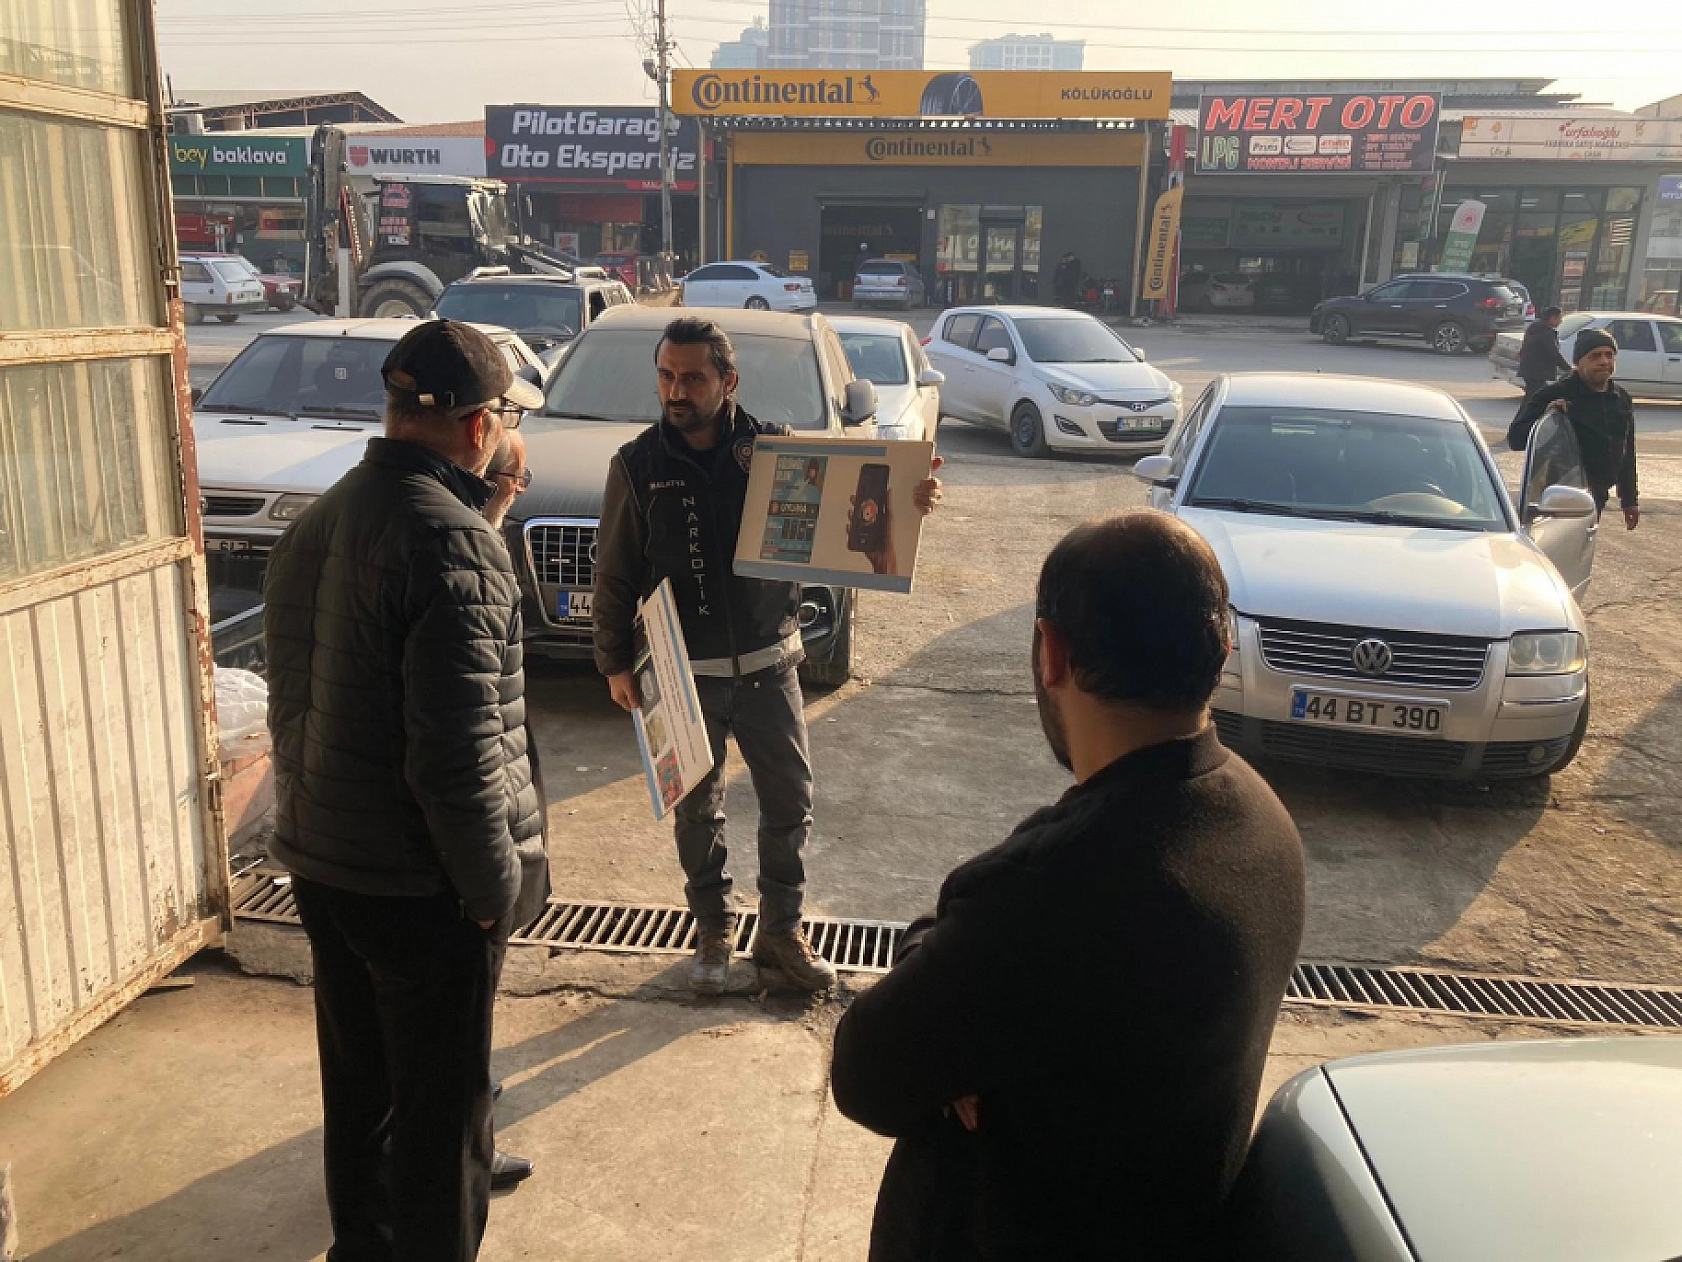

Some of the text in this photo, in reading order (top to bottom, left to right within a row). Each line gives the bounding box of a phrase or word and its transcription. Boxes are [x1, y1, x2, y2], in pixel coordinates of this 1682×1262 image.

[692, 74, 853, 110] Continental
[1061, 86, 1153, 100] KÖLÜKOĞLU
[1204, 95, 1435, 131] MERT OTO
[174, 141, 287, 169] bey baklava
[500, 144, 551, 169] Oto
[865, 136, 975, 160] Continental
[1202, 135, 1240, 170] LPG
[1149, 215, 1172, 292] Continental
[570, 593, 592, 614] 44
[1306, 696, 1440, 731] 44 BT 390
